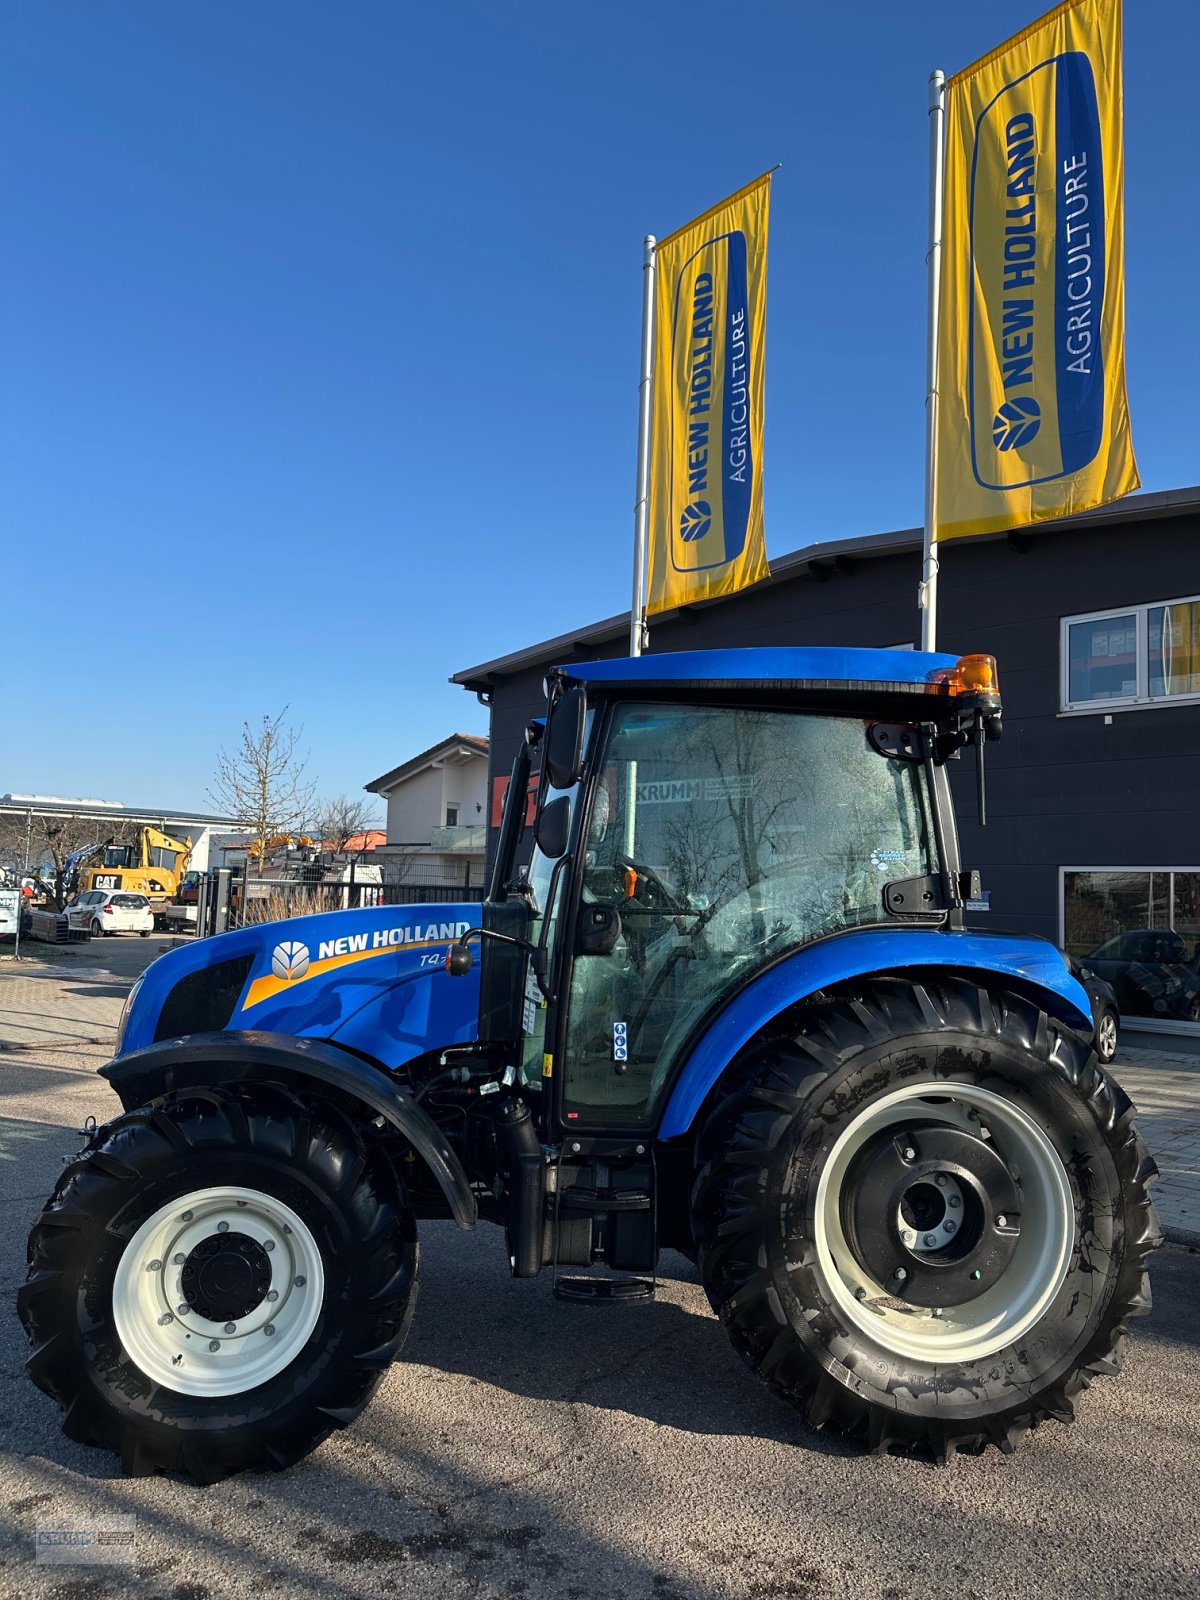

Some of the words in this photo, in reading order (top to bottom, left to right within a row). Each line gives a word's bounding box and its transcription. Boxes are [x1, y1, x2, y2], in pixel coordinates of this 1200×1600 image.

[1003, 112, 1036, 291] HOLLAND
[1063, 151, 1092, 374] AGRICULTURE
[690, 272, 714, 416] HOLLAND
[1003, 299, 1034, 390] NEW
[729, 307, 747, 482] AGRICULTURE
[688, 422, 710, 495] NEW
[636, 782, 701, 801] KRUMM
[95, 875, 117, 889] CAT
[318, 933, 369, 959] NEW
[372, 921, 471, 949] HOLLAND
